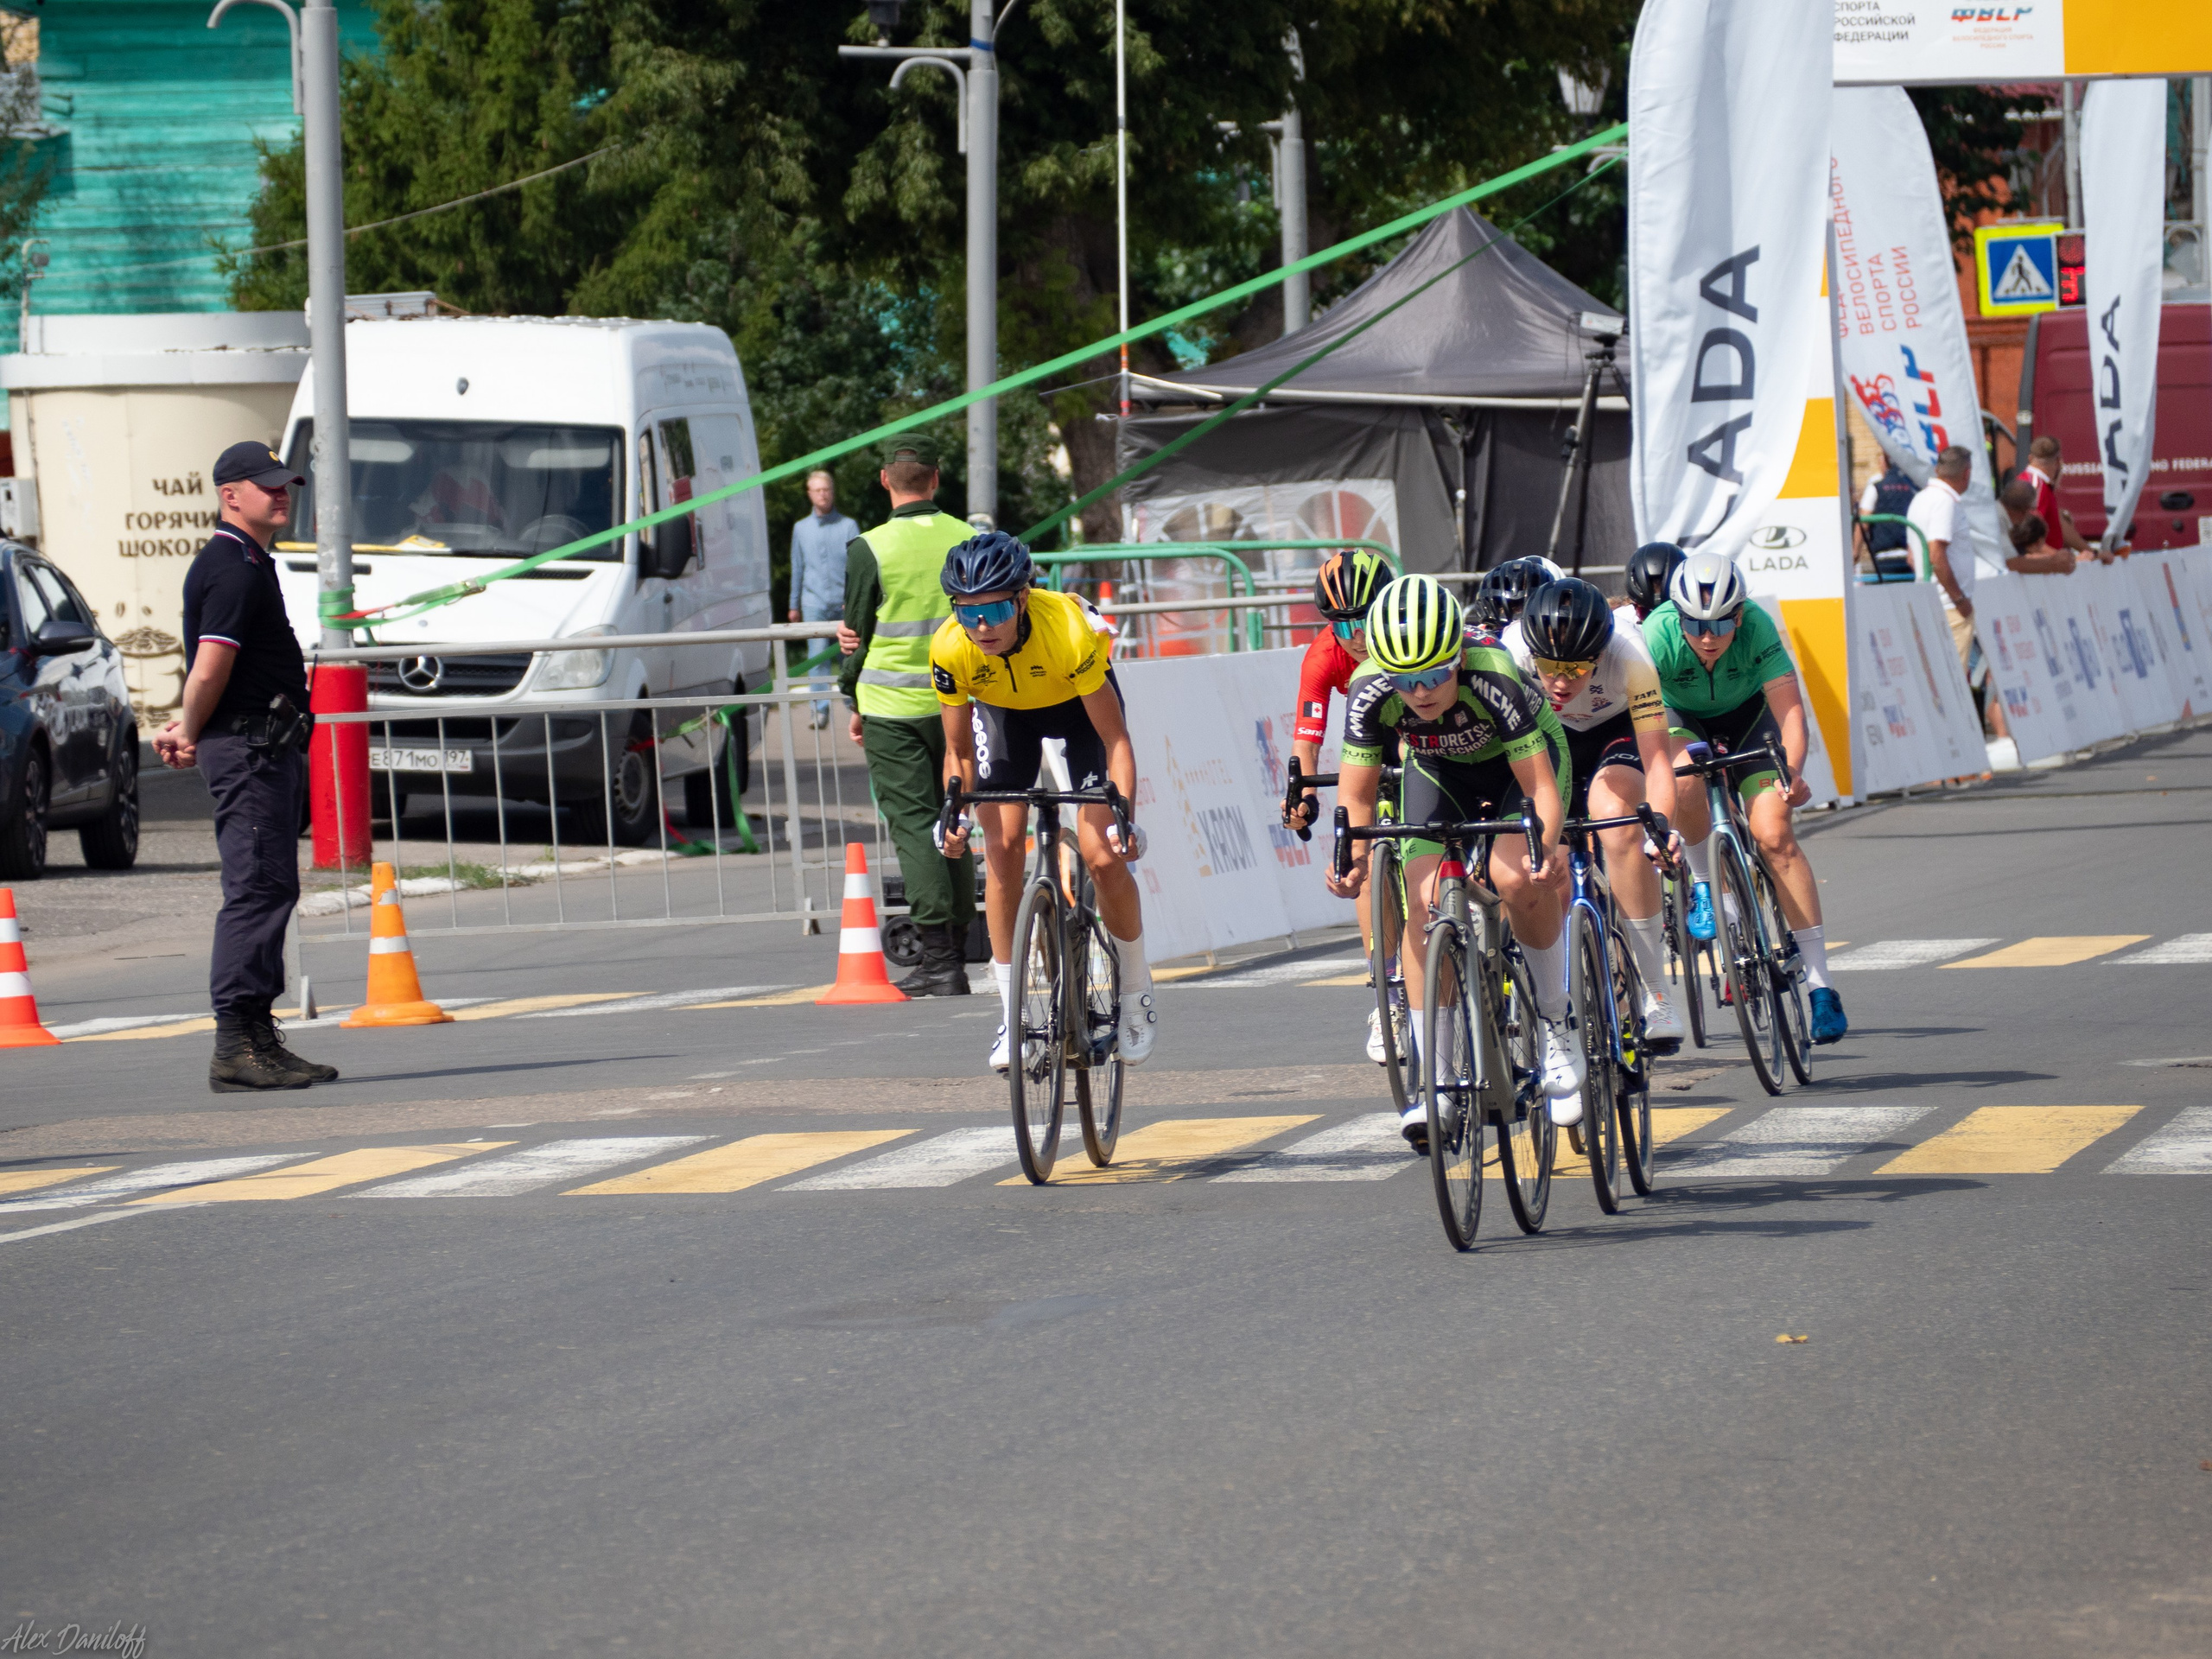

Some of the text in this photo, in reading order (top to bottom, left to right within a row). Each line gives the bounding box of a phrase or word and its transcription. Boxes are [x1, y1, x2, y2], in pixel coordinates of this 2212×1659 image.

[1834, 13, 1916, 26] РОССИЙСКОЙ
[1834, 31, 1910, 42] ФЕДЕРАЦИИ
[1867, 253, 1897, 332] СПОРТА
[1891, 246, 1922, 329] РОССИИ
[152, 471, 203, 496] ЧАЙ
[125, 511, 216, 531] ГОРЯЧИ
[118, 537, 208, 557] ШОКОЛ
[1750, 556, 1808, 571] LADA
